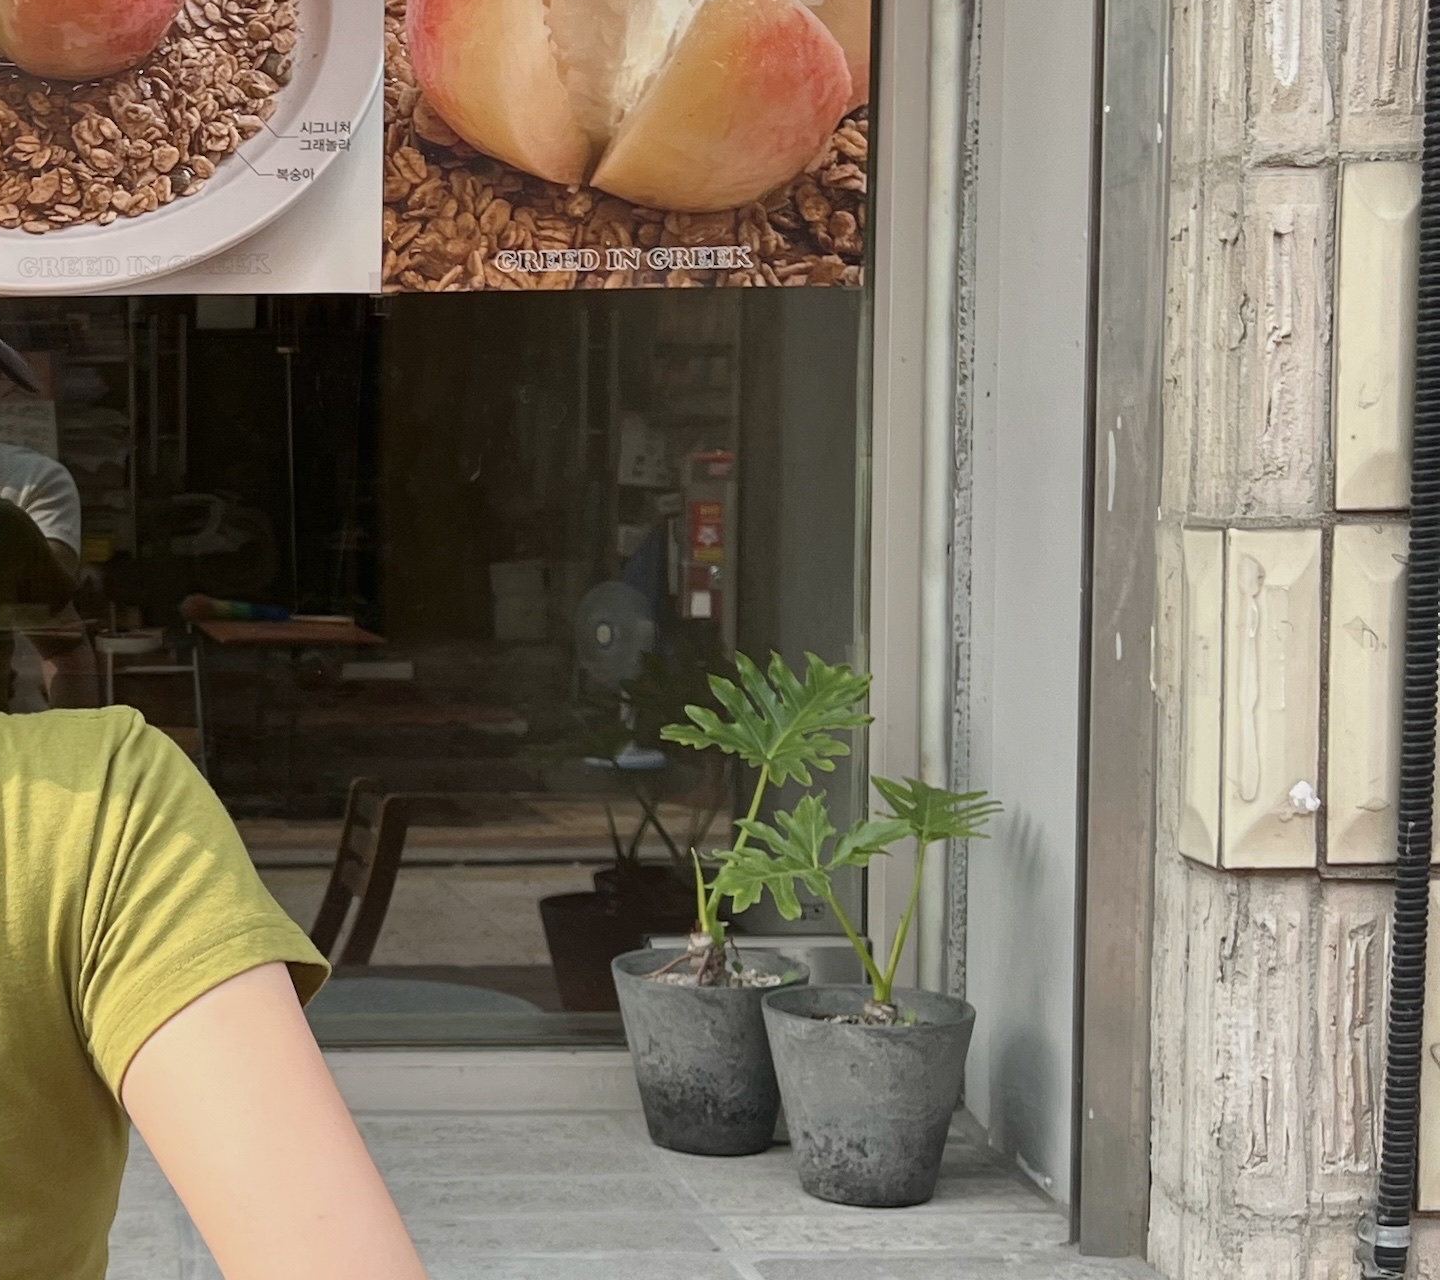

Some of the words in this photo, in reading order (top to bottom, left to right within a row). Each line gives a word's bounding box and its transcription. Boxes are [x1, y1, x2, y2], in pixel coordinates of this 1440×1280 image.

[300, 121, 352, 134] 시그니처
[299, 138, 352, 152] 그래놀라
[276, 167, 315, 182] 복숭아
[494, 248, 601, 272] GREED
[605, 247, 641, 271] IN
[646, 245, 755, 270] GREEK
[17, 256, 121, 278] GREED
[126, 255, 161, 277] IN
